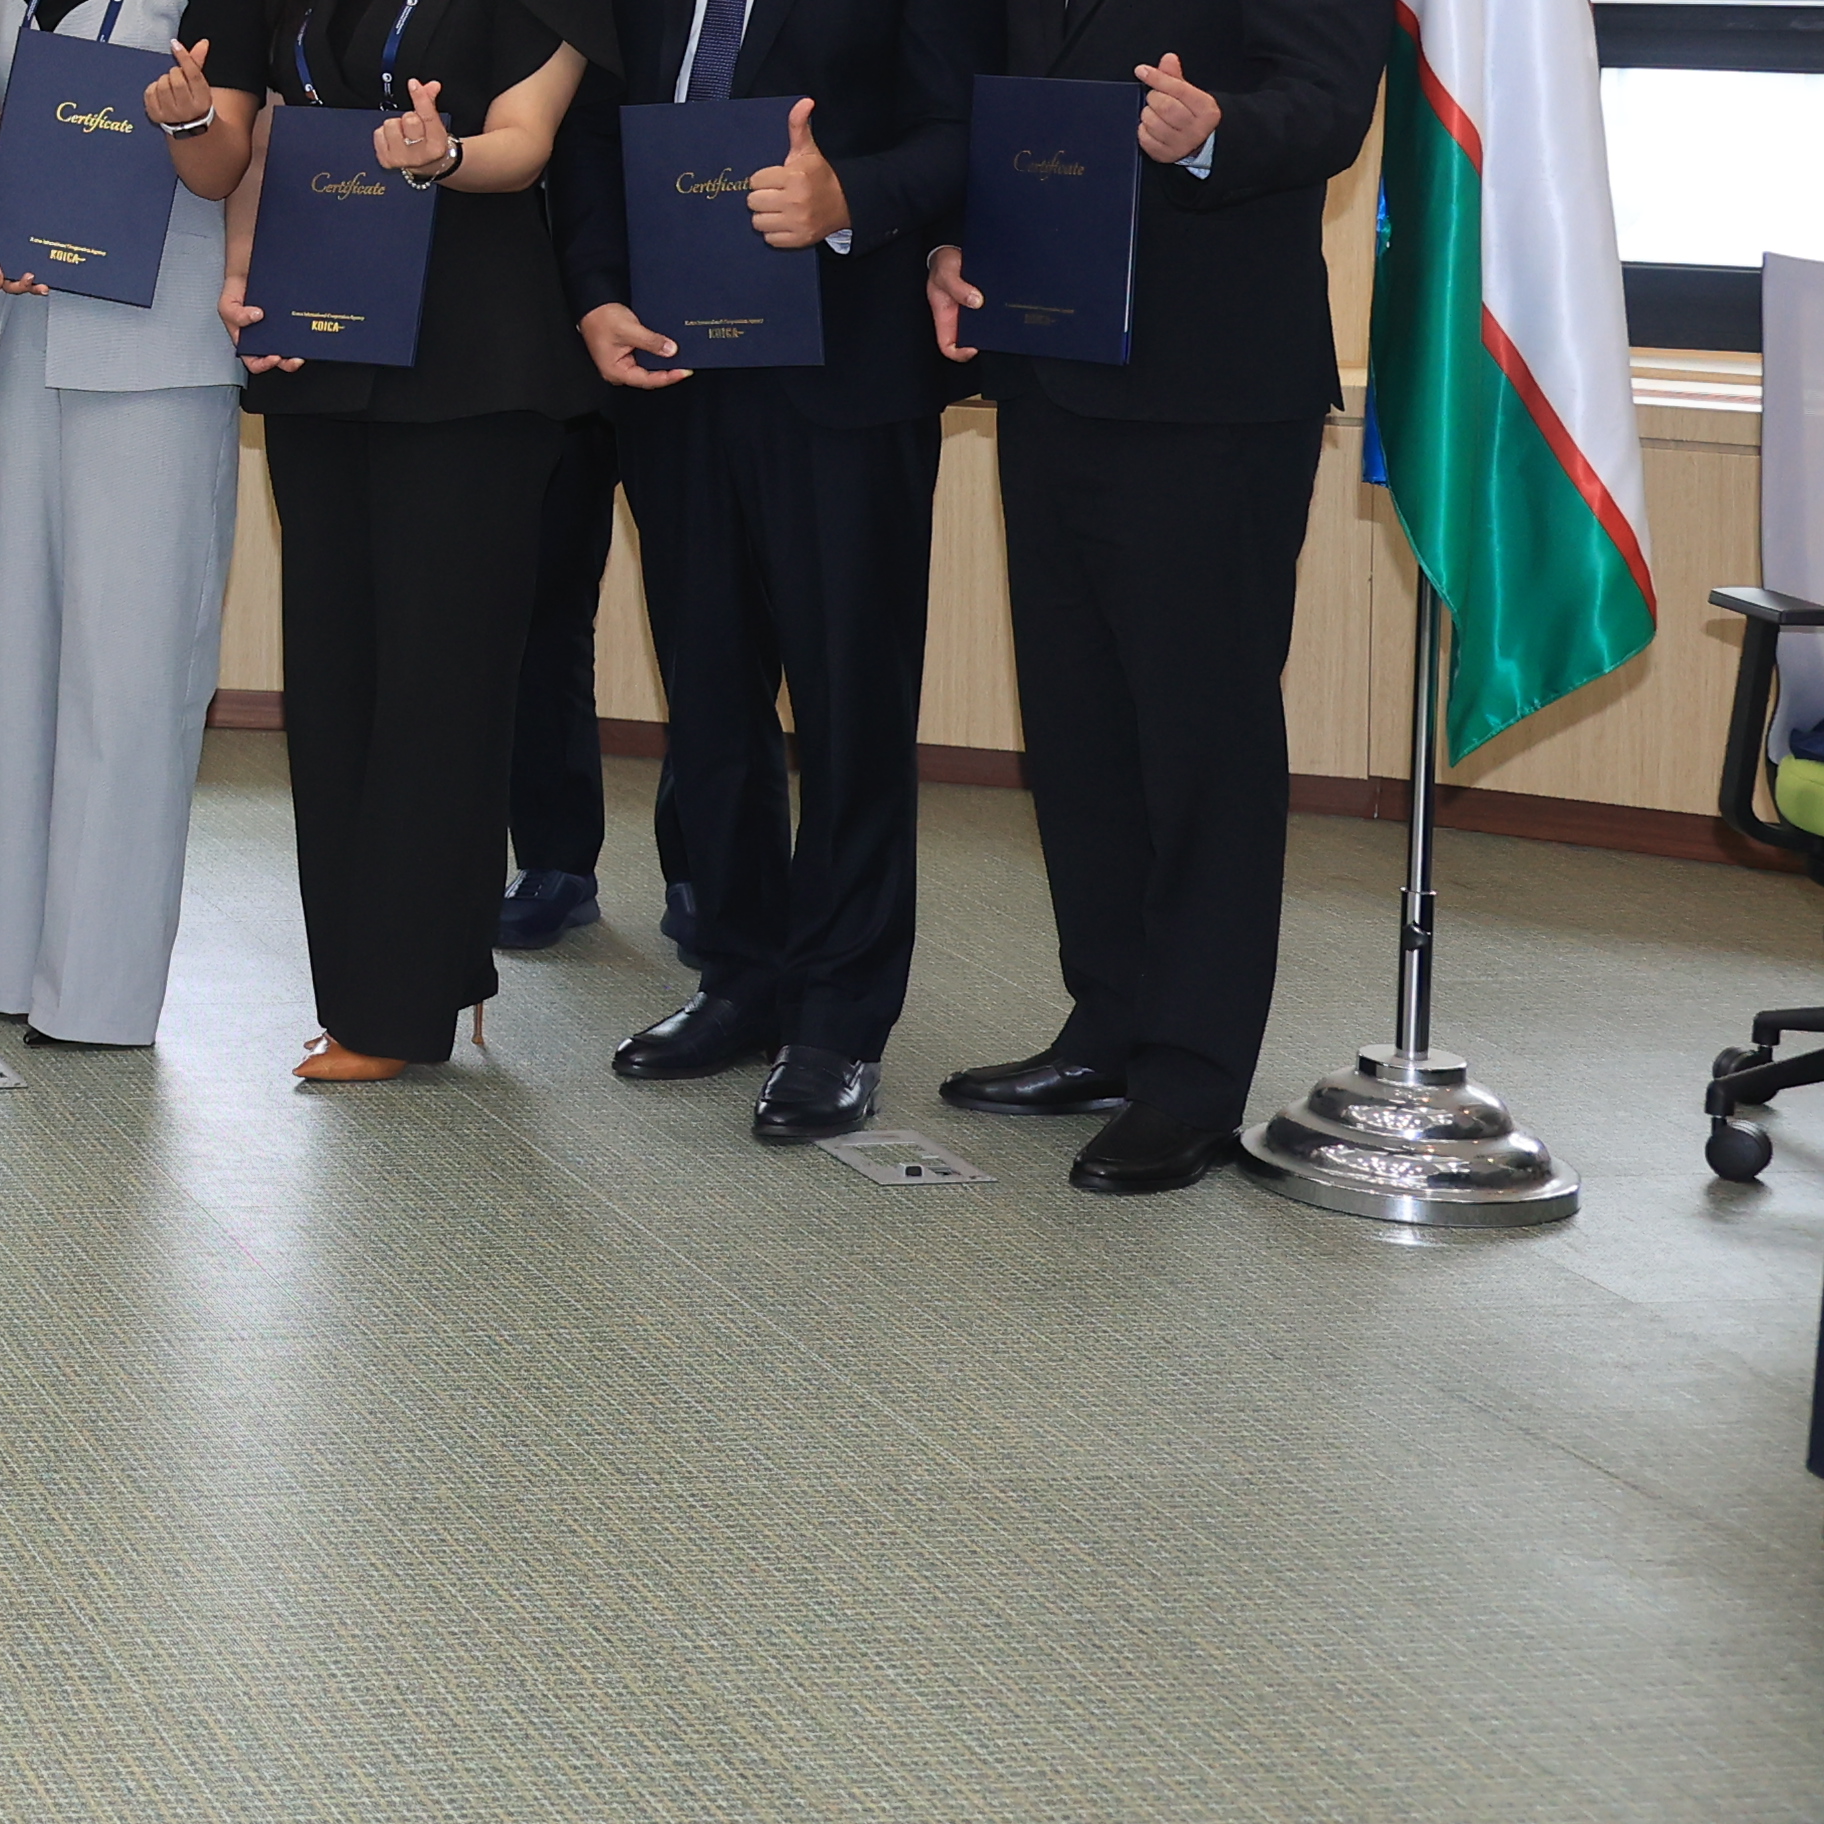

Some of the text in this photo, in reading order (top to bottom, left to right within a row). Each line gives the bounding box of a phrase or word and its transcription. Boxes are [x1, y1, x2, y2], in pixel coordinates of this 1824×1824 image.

[56, 101, 133, 133] Certificate
[311, 171, 386, 201] Certificate
[675, 167, 753, 199] Certificat
[50, 249, 80, 264] KOICA
[312, 320, 340, 332] KOICA
